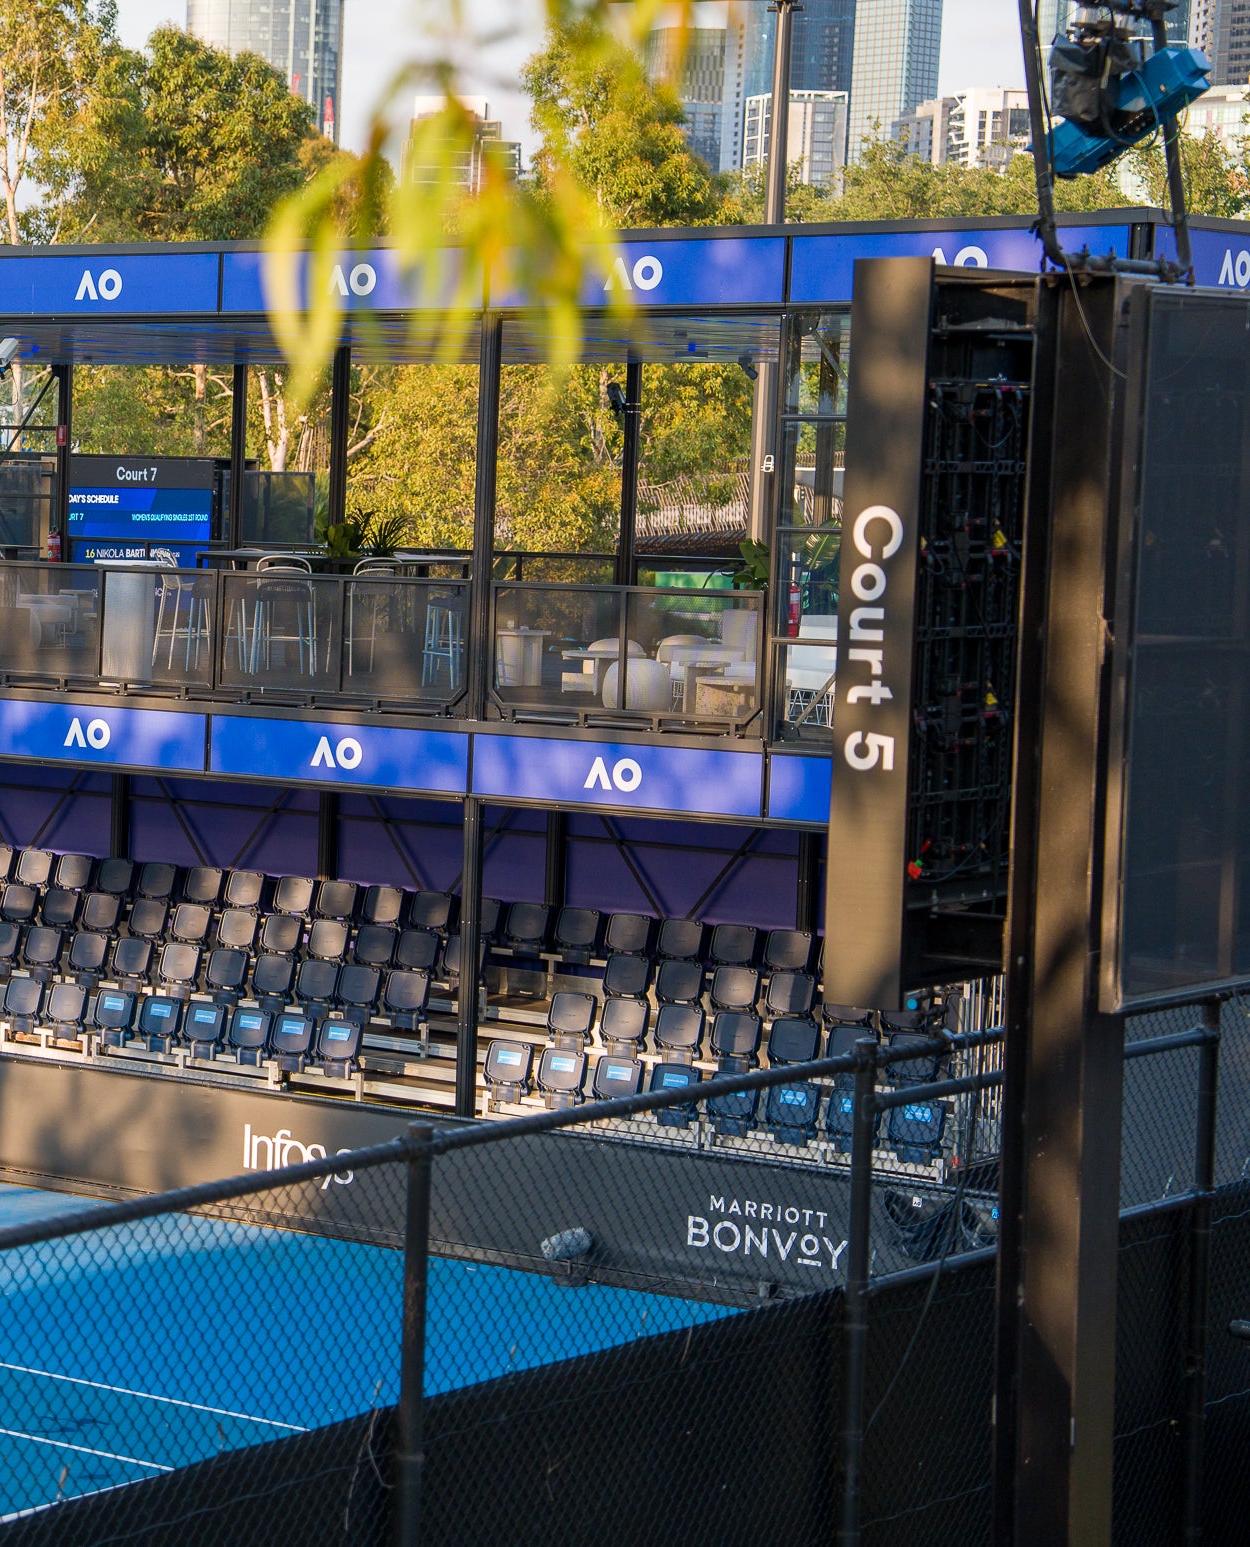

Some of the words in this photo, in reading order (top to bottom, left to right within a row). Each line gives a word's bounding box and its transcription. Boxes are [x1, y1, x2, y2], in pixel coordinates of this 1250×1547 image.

[327, 263, 377, 297] AO
[603, 255, 663, 291] AO
[1218, 249, 1250, 287] AO
[74, 269, 123, 301] AO
[116, 466, 148, 482] Court
[150, 467, 158, 482] 7
[87, 494, 120, 504] SCHEDULE
[85, 549, 95, 558] 16
[96, 548, 125, 558] NIKOLA
[846, 504, 904, 705] Court
[64, 718, 111, 751] AO
[844, 730, 895, 772] 5
[311, 737, 363, 770] AO
[583, 757, 643, 793] AO
[709, 1195, 828, 1228] MARRIOTT
[687, 1216, 849, 1269] BONVOY
